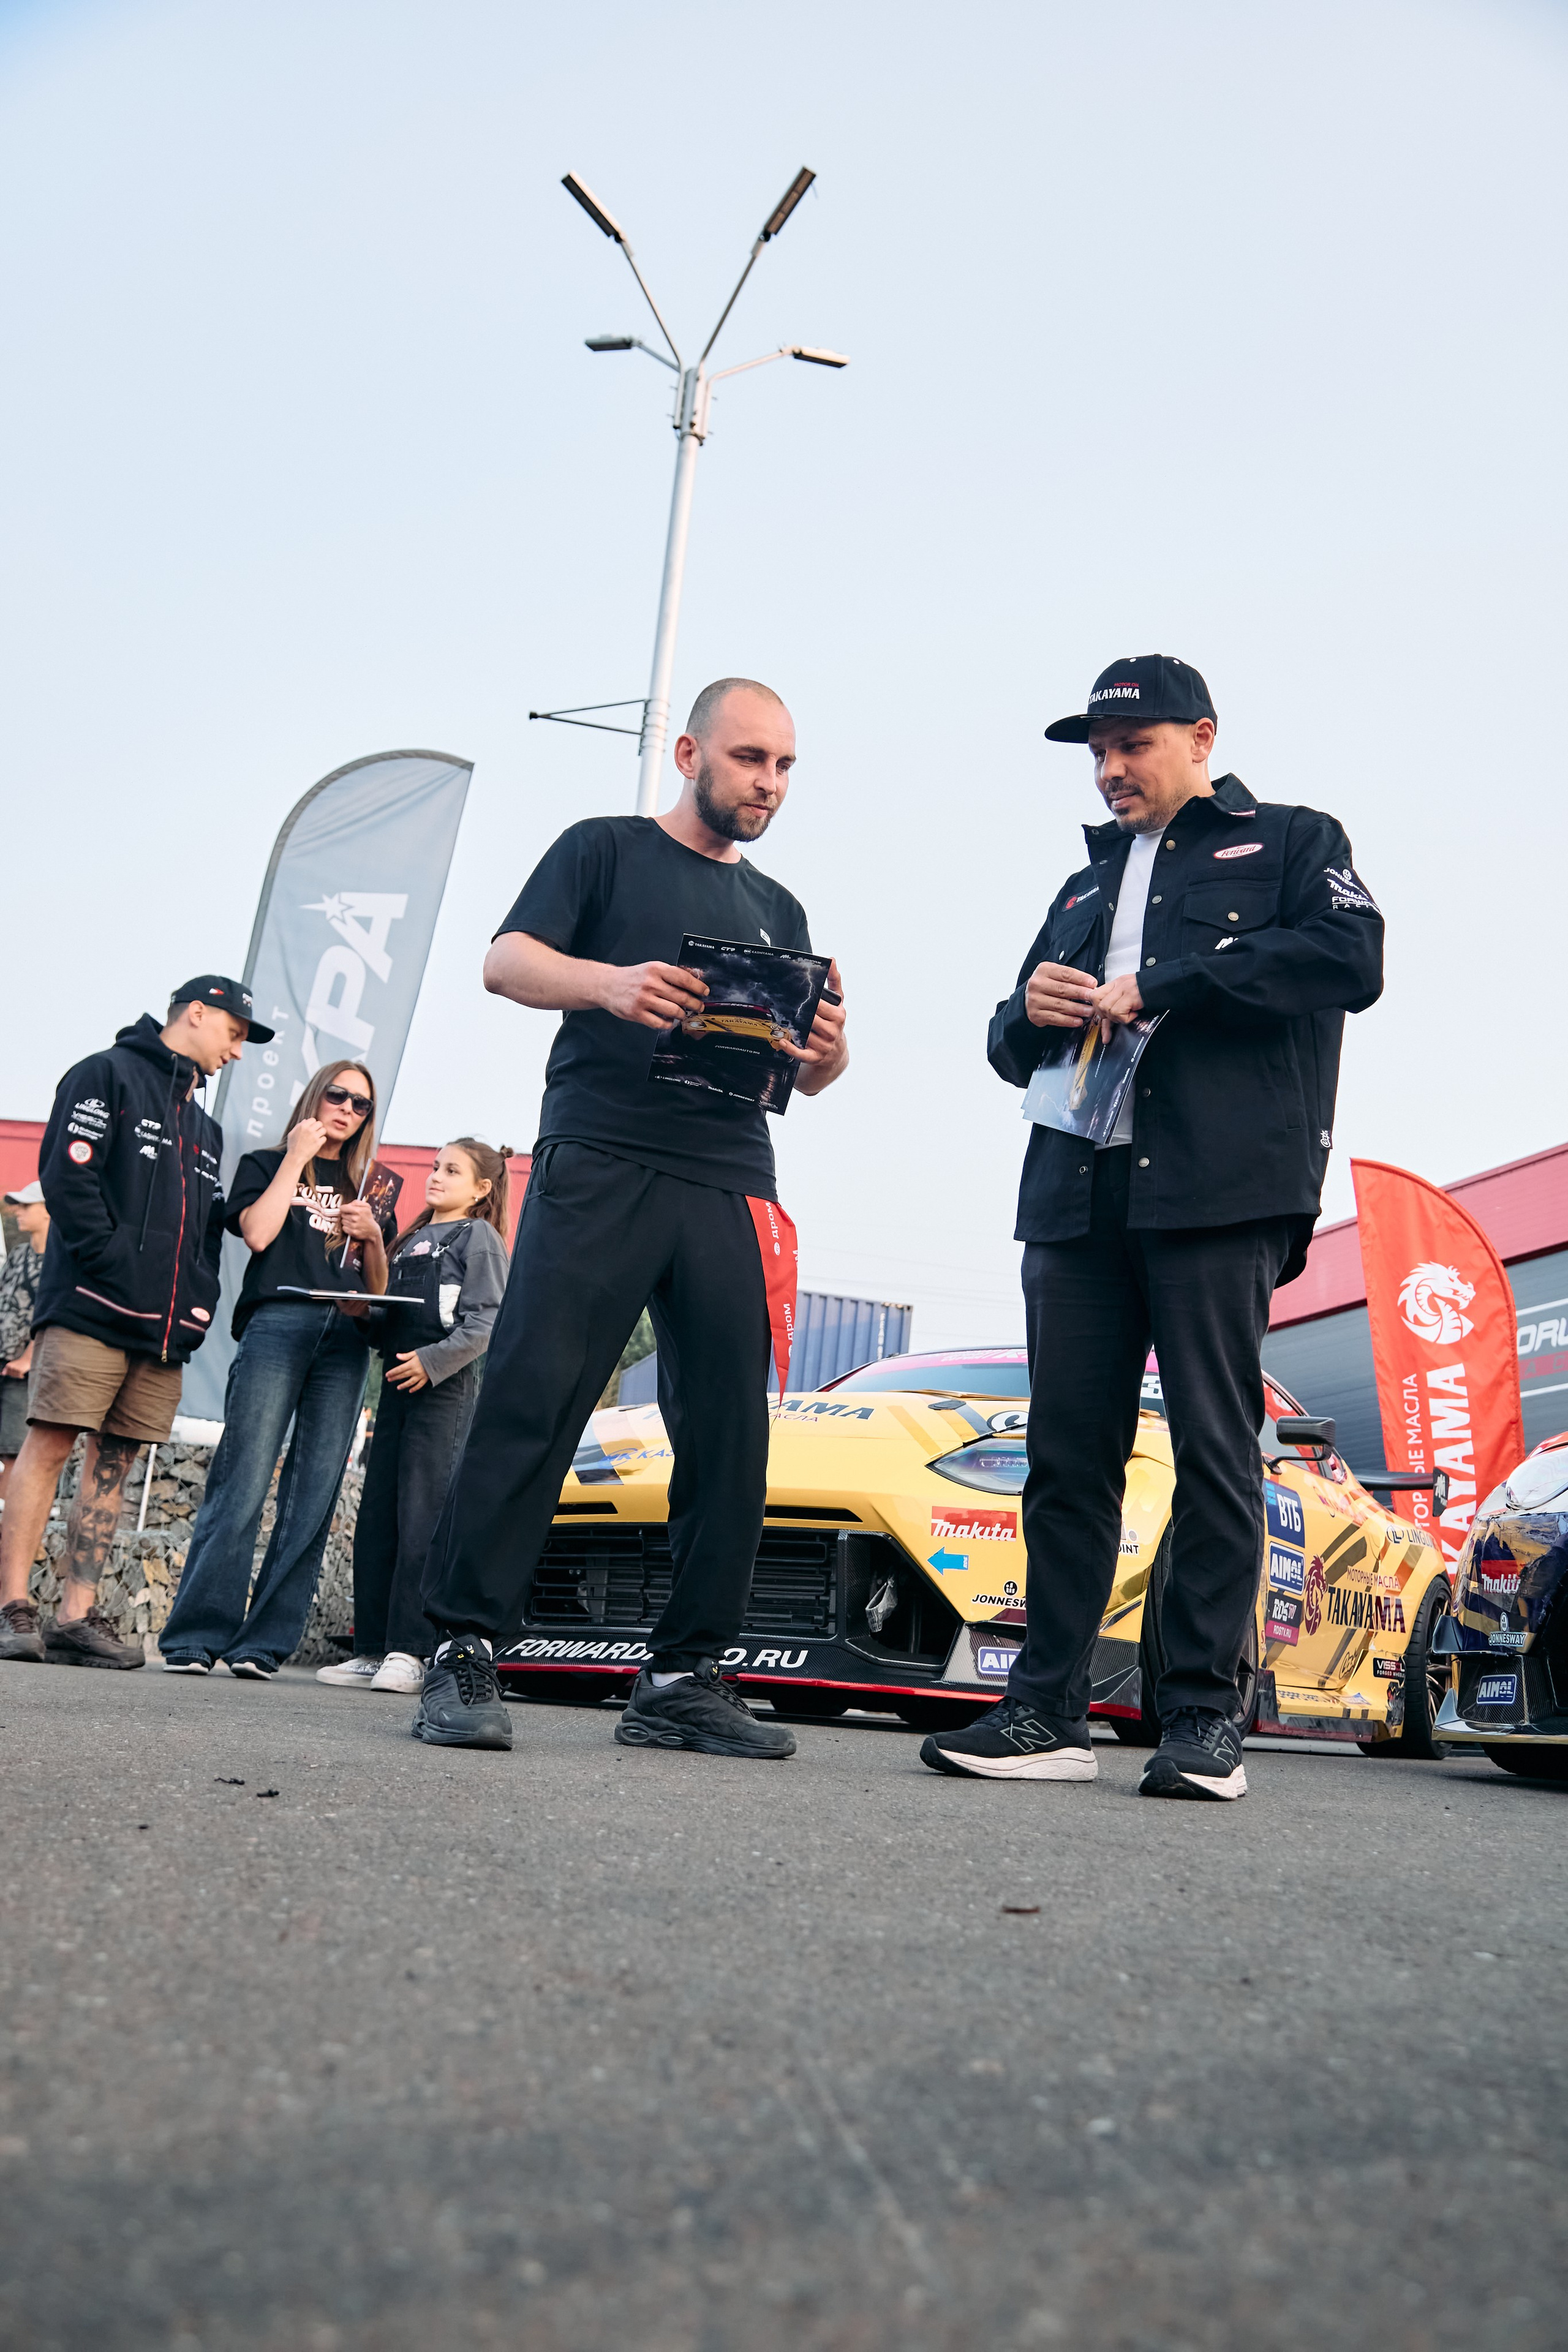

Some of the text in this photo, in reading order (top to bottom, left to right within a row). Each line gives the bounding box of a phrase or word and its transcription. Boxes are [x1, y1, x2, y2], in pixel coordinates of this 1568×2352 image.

[1088, 687, 1140, 705] TAKAYAMA
[1221, 845, 1257, 858] Forward
[765, 1202, 779, 1239] дром
[783, 1303, 795, 1341] дром
[1402, 1373, 1423, 1445] МАСЛА
[636, 1448, 674, 1460] KAS
[1276, 1493, 1302, 1533] ВТБ
[931, 1518, 1017, 1542] makita
[1270, 1552, 1303, 1586] AIMOL
[1348, 1565, 1401, 1590] МОТОРНЫЕ МАСЛА
[972, 1594, 1027, 1608] JONNESW
[1327, 1586, 1406, 1634] TAKAYAMA
[1273, 1624, 1292, 1639] RDSTV.RU
[1489, 1633, 1526, 1646] JONNESWAY
[1376, 1659, 1406, 1672] VISSOL
[1479, 1680, 1514, 1698] AIMOL
